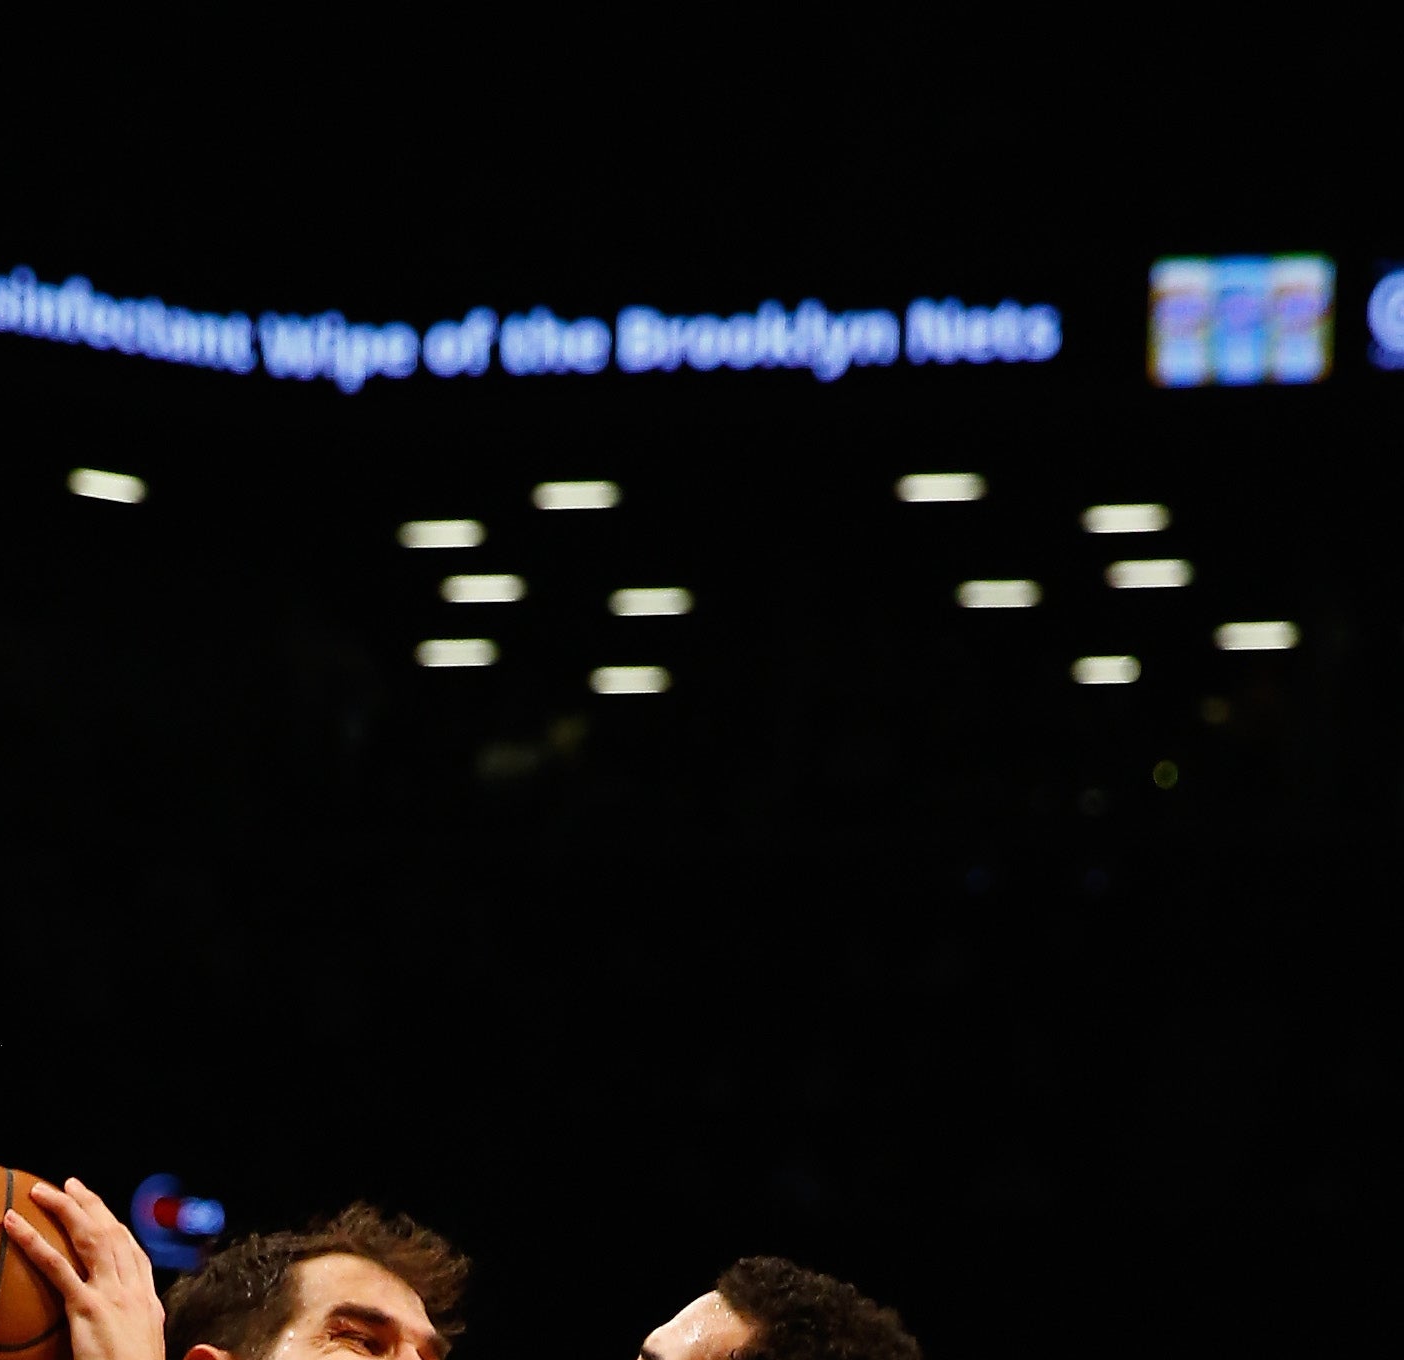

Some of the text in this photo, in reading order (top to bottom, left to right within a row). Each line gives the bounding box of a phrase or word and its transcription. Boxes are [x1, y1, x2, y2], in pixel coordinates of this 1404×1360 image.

[257, 308, 419, 393] Wipe
[422, 306, 498, 378] of
[500, 305, 612, 375] the
[615, 298, 900, 382] Brooklyn
[904, 297, 1063, 364] Nets
